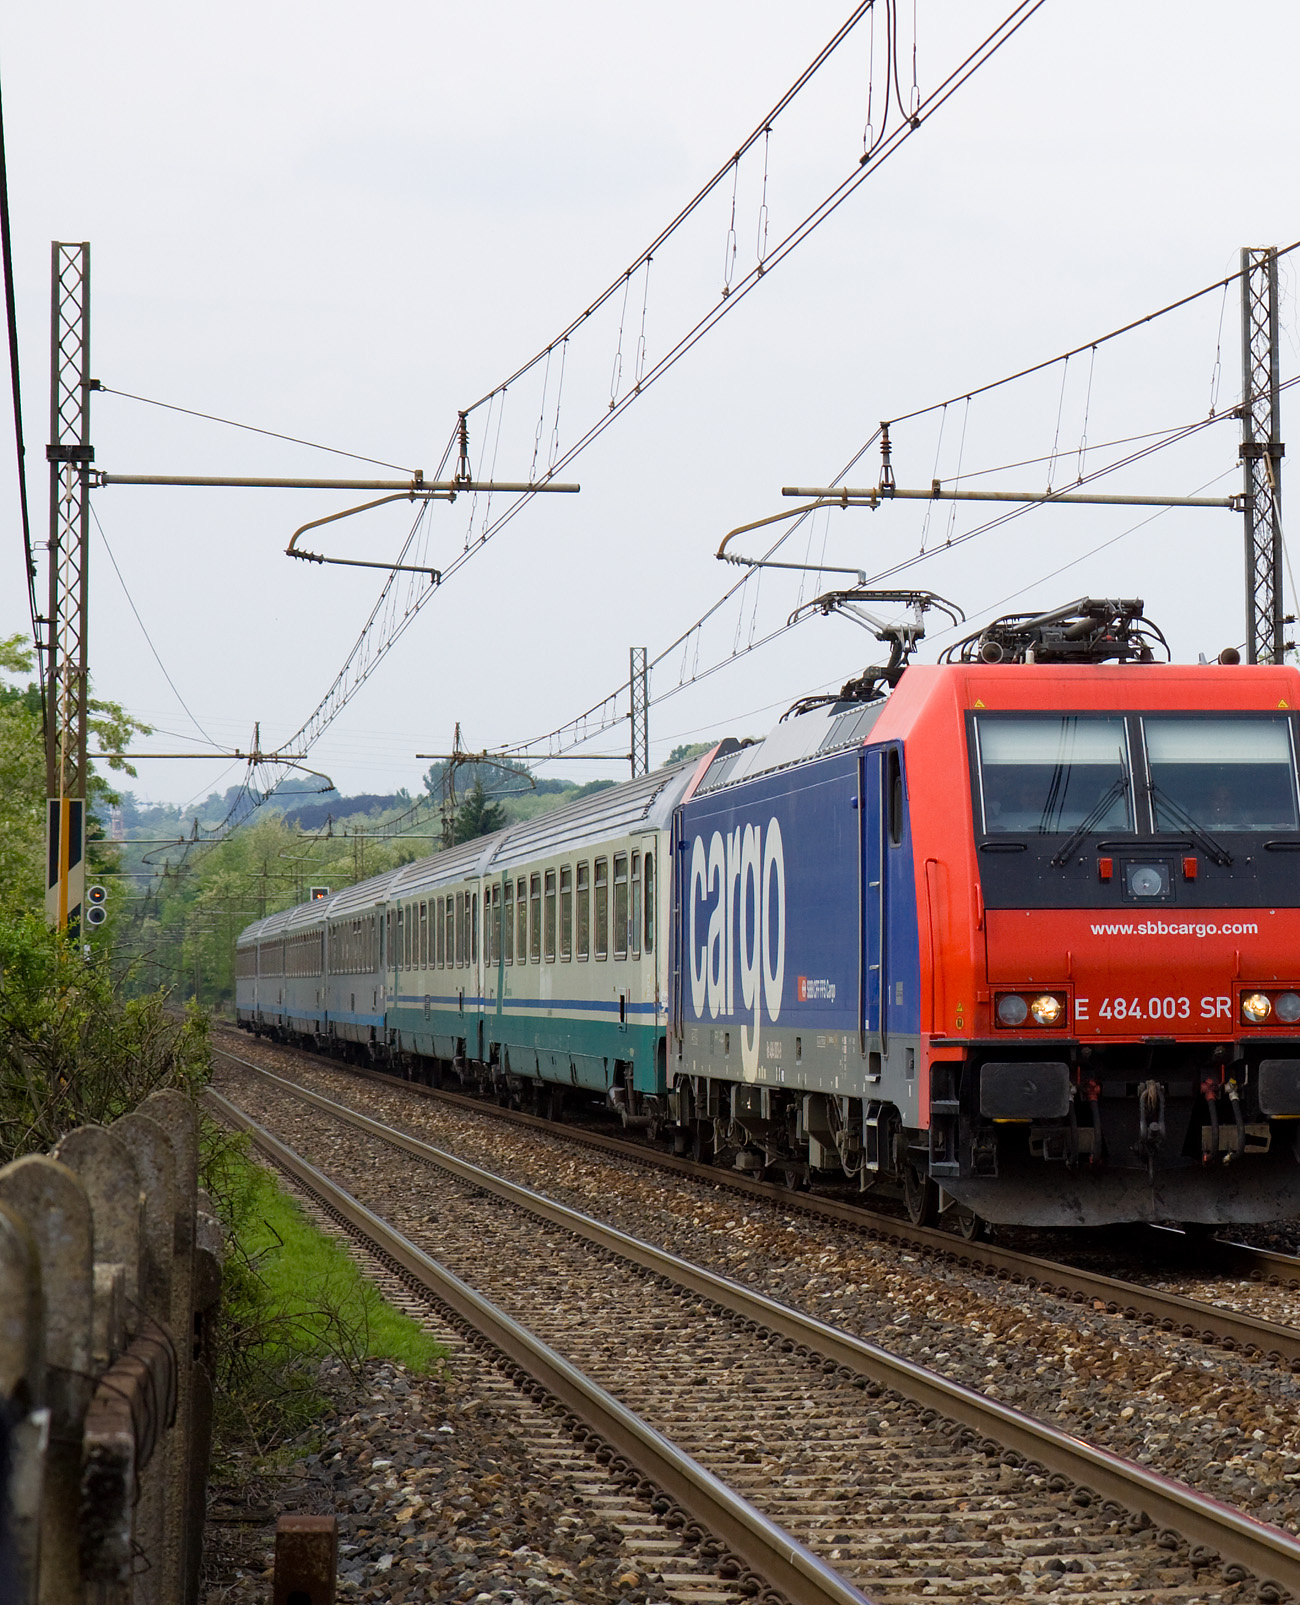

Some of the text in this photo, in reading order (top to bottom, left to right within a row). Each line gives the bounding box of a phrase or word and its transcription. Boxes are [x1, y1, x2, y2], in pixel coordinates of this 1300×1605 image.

[1090, 921, 1258, 938] www.sbbcargo.com
[689, 816, 786, 1083] cargo
[1074, 996, 1232, 1020] E 484.003 SR
